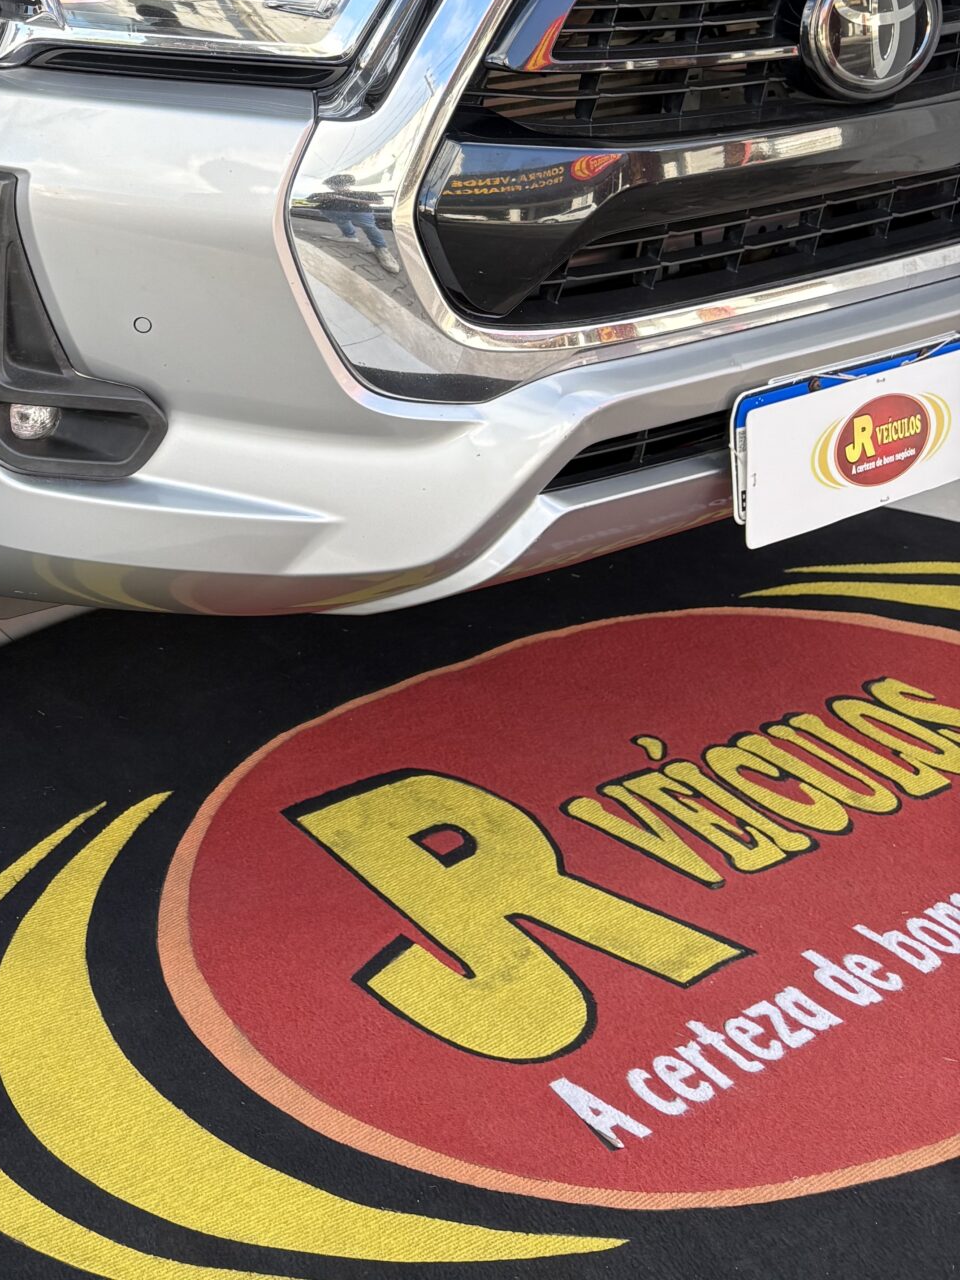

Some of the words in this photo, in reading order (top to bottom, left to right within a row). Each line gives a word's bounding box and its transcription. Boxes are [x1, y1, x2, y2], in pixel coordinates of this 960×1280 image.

[845, 414, 876, 463] JR
[875, 414, 922, 446] VEÍCULOS
[851, 464, 857, 475] A
[856, 460, 876, 474] certeza
[876, 457, 883, 467] de
[883, 455, 895, 466] bom
[281, 767, 756, 1063] JR
[549, 1077, 653, 1150] A
[626, 985, 844, 1116] certeza
[800, 949, 903, 1007] de
